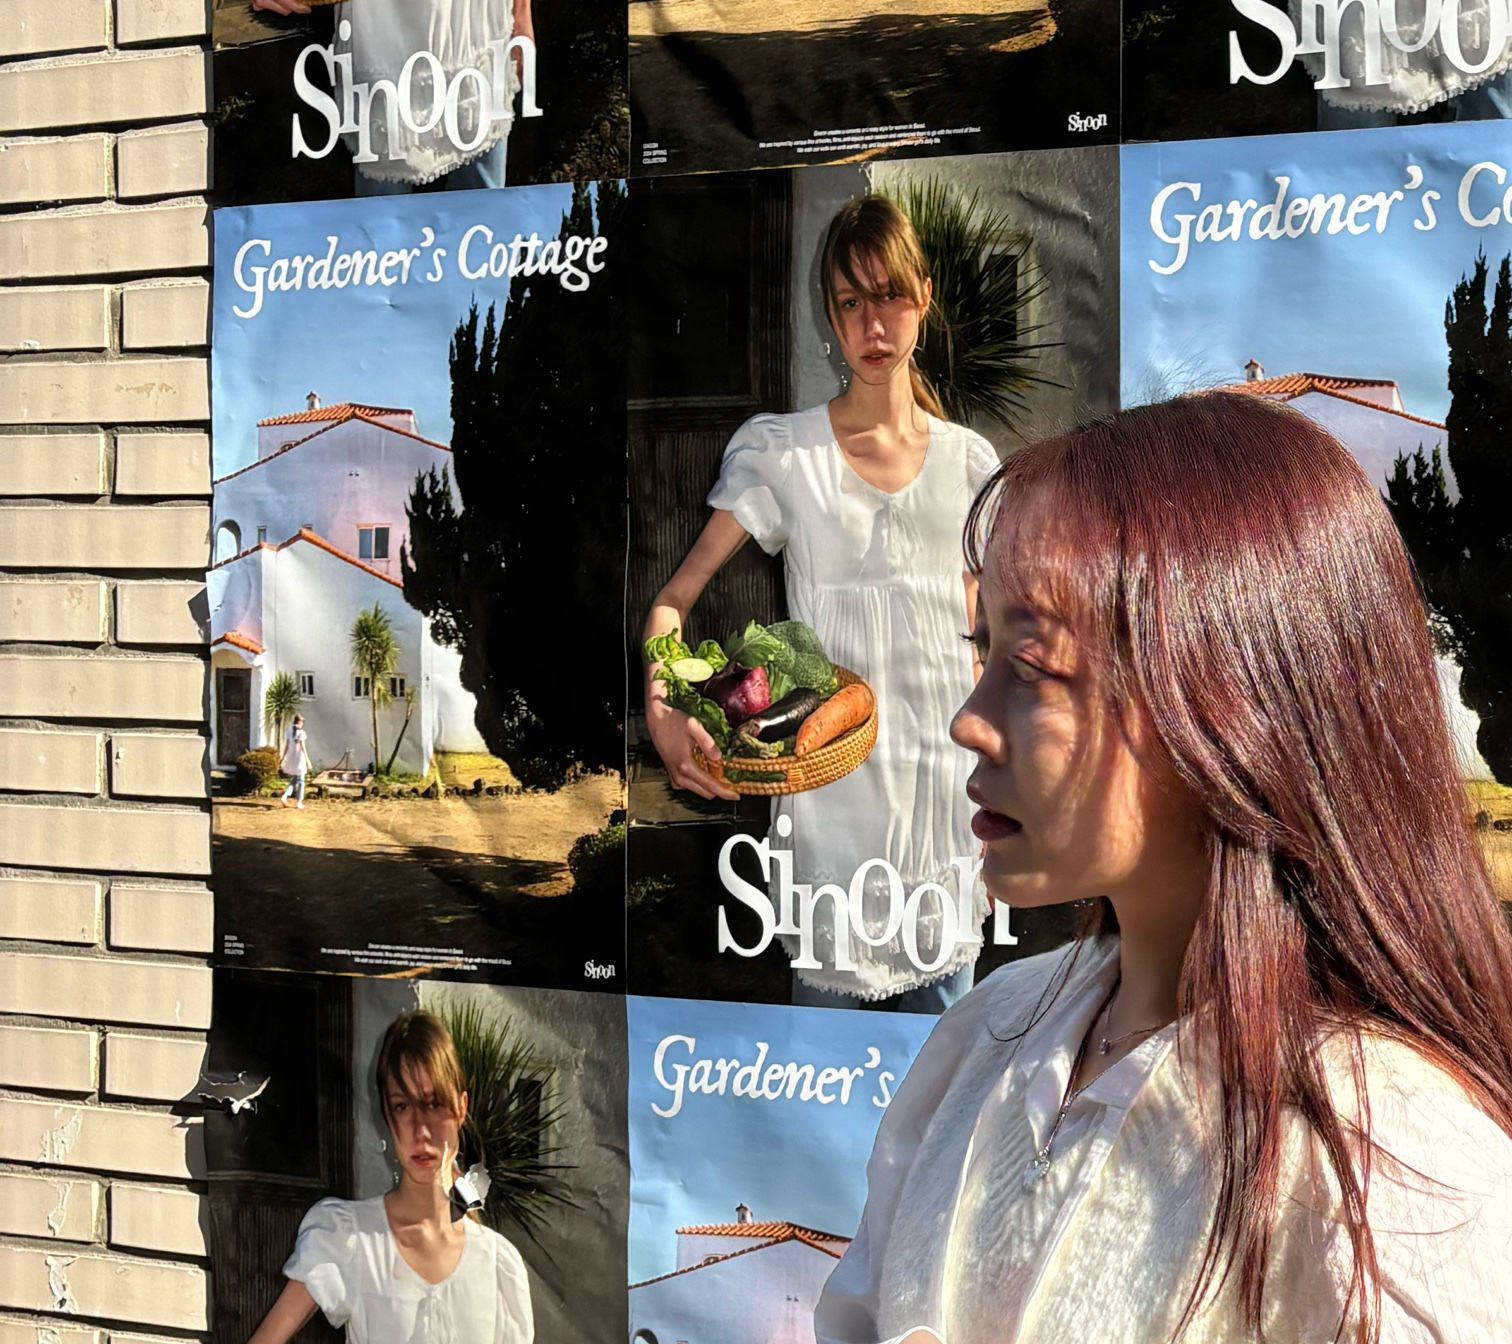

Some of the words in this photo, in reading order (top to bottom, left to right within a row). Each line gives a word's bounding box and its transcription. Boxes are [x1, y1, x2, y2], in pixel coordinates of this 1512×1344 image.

[292, 19, 544, 163] Sinoon
[1067, 112, 1108, 132] Sinoon
[1149, 165, 1441, 276] Gardener's
[233, 226, 447, 316] Gardener's
[457, 224, 608, 292] Cottage
[651, 1034, 895, 1118] Gardener's
